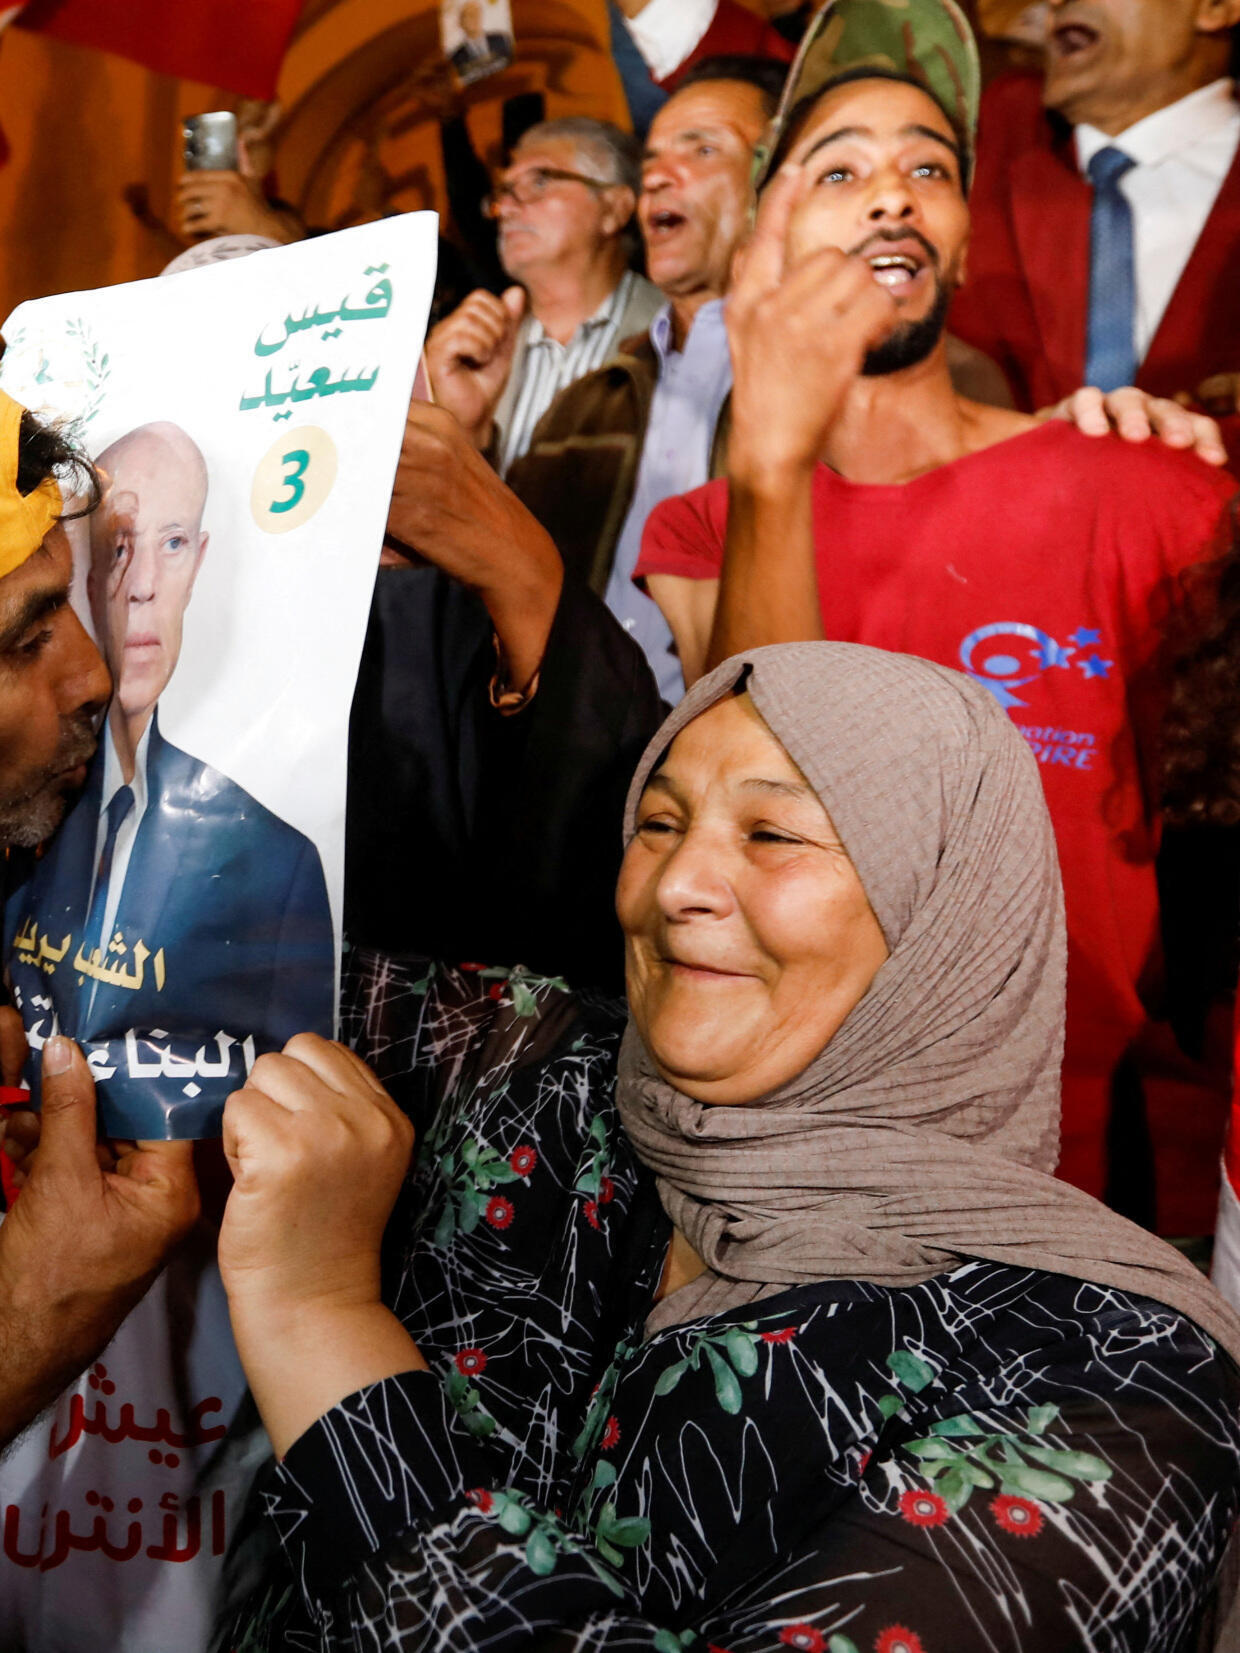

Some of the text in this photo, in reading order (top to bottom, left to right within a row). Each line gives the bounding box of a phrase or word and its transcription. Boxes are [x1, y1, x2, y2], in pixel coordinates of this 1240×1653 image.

[254, 263, 394, 357] قيس
[268, 449, 311, 514] 3
[48, 1362, 227, 1469] عيش
